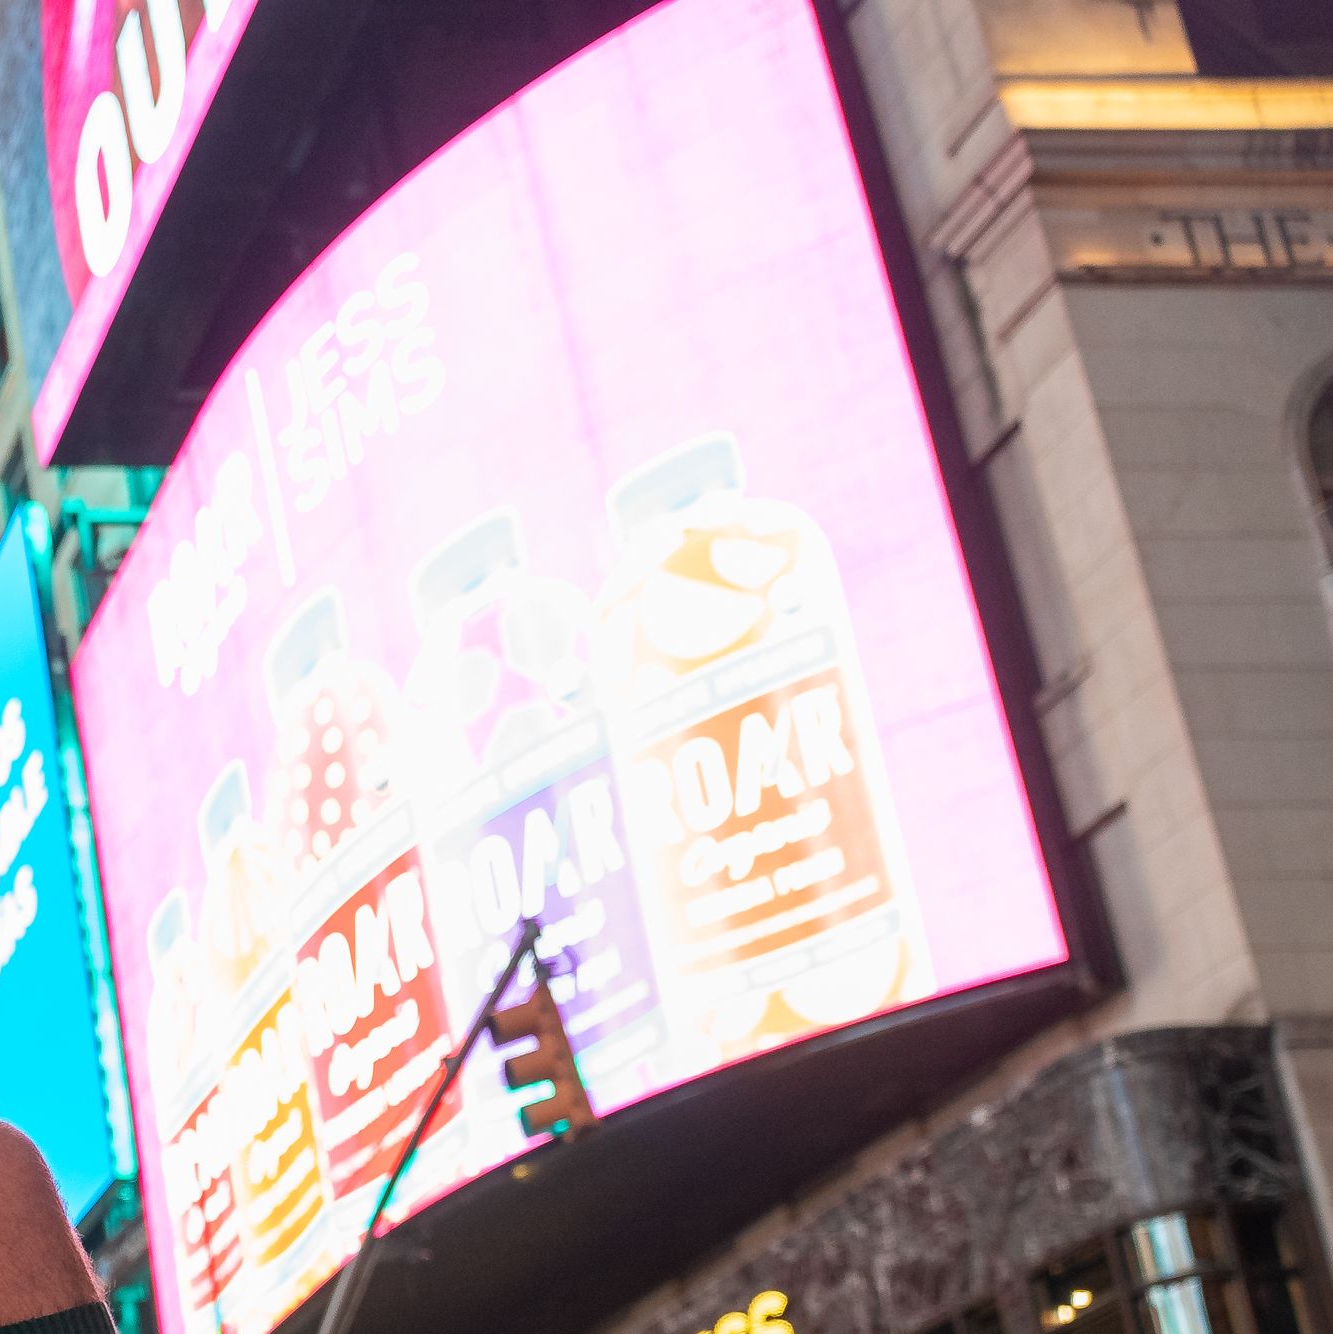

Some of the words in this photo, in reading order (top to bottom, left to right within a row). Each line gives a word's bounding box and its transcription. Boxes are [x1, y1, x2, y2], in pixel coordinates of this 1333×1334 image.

[1157, 207, 1313, 268] THE
[280, 327, 446, 514] SIMS
[281, 252, 431, 447] JESS
